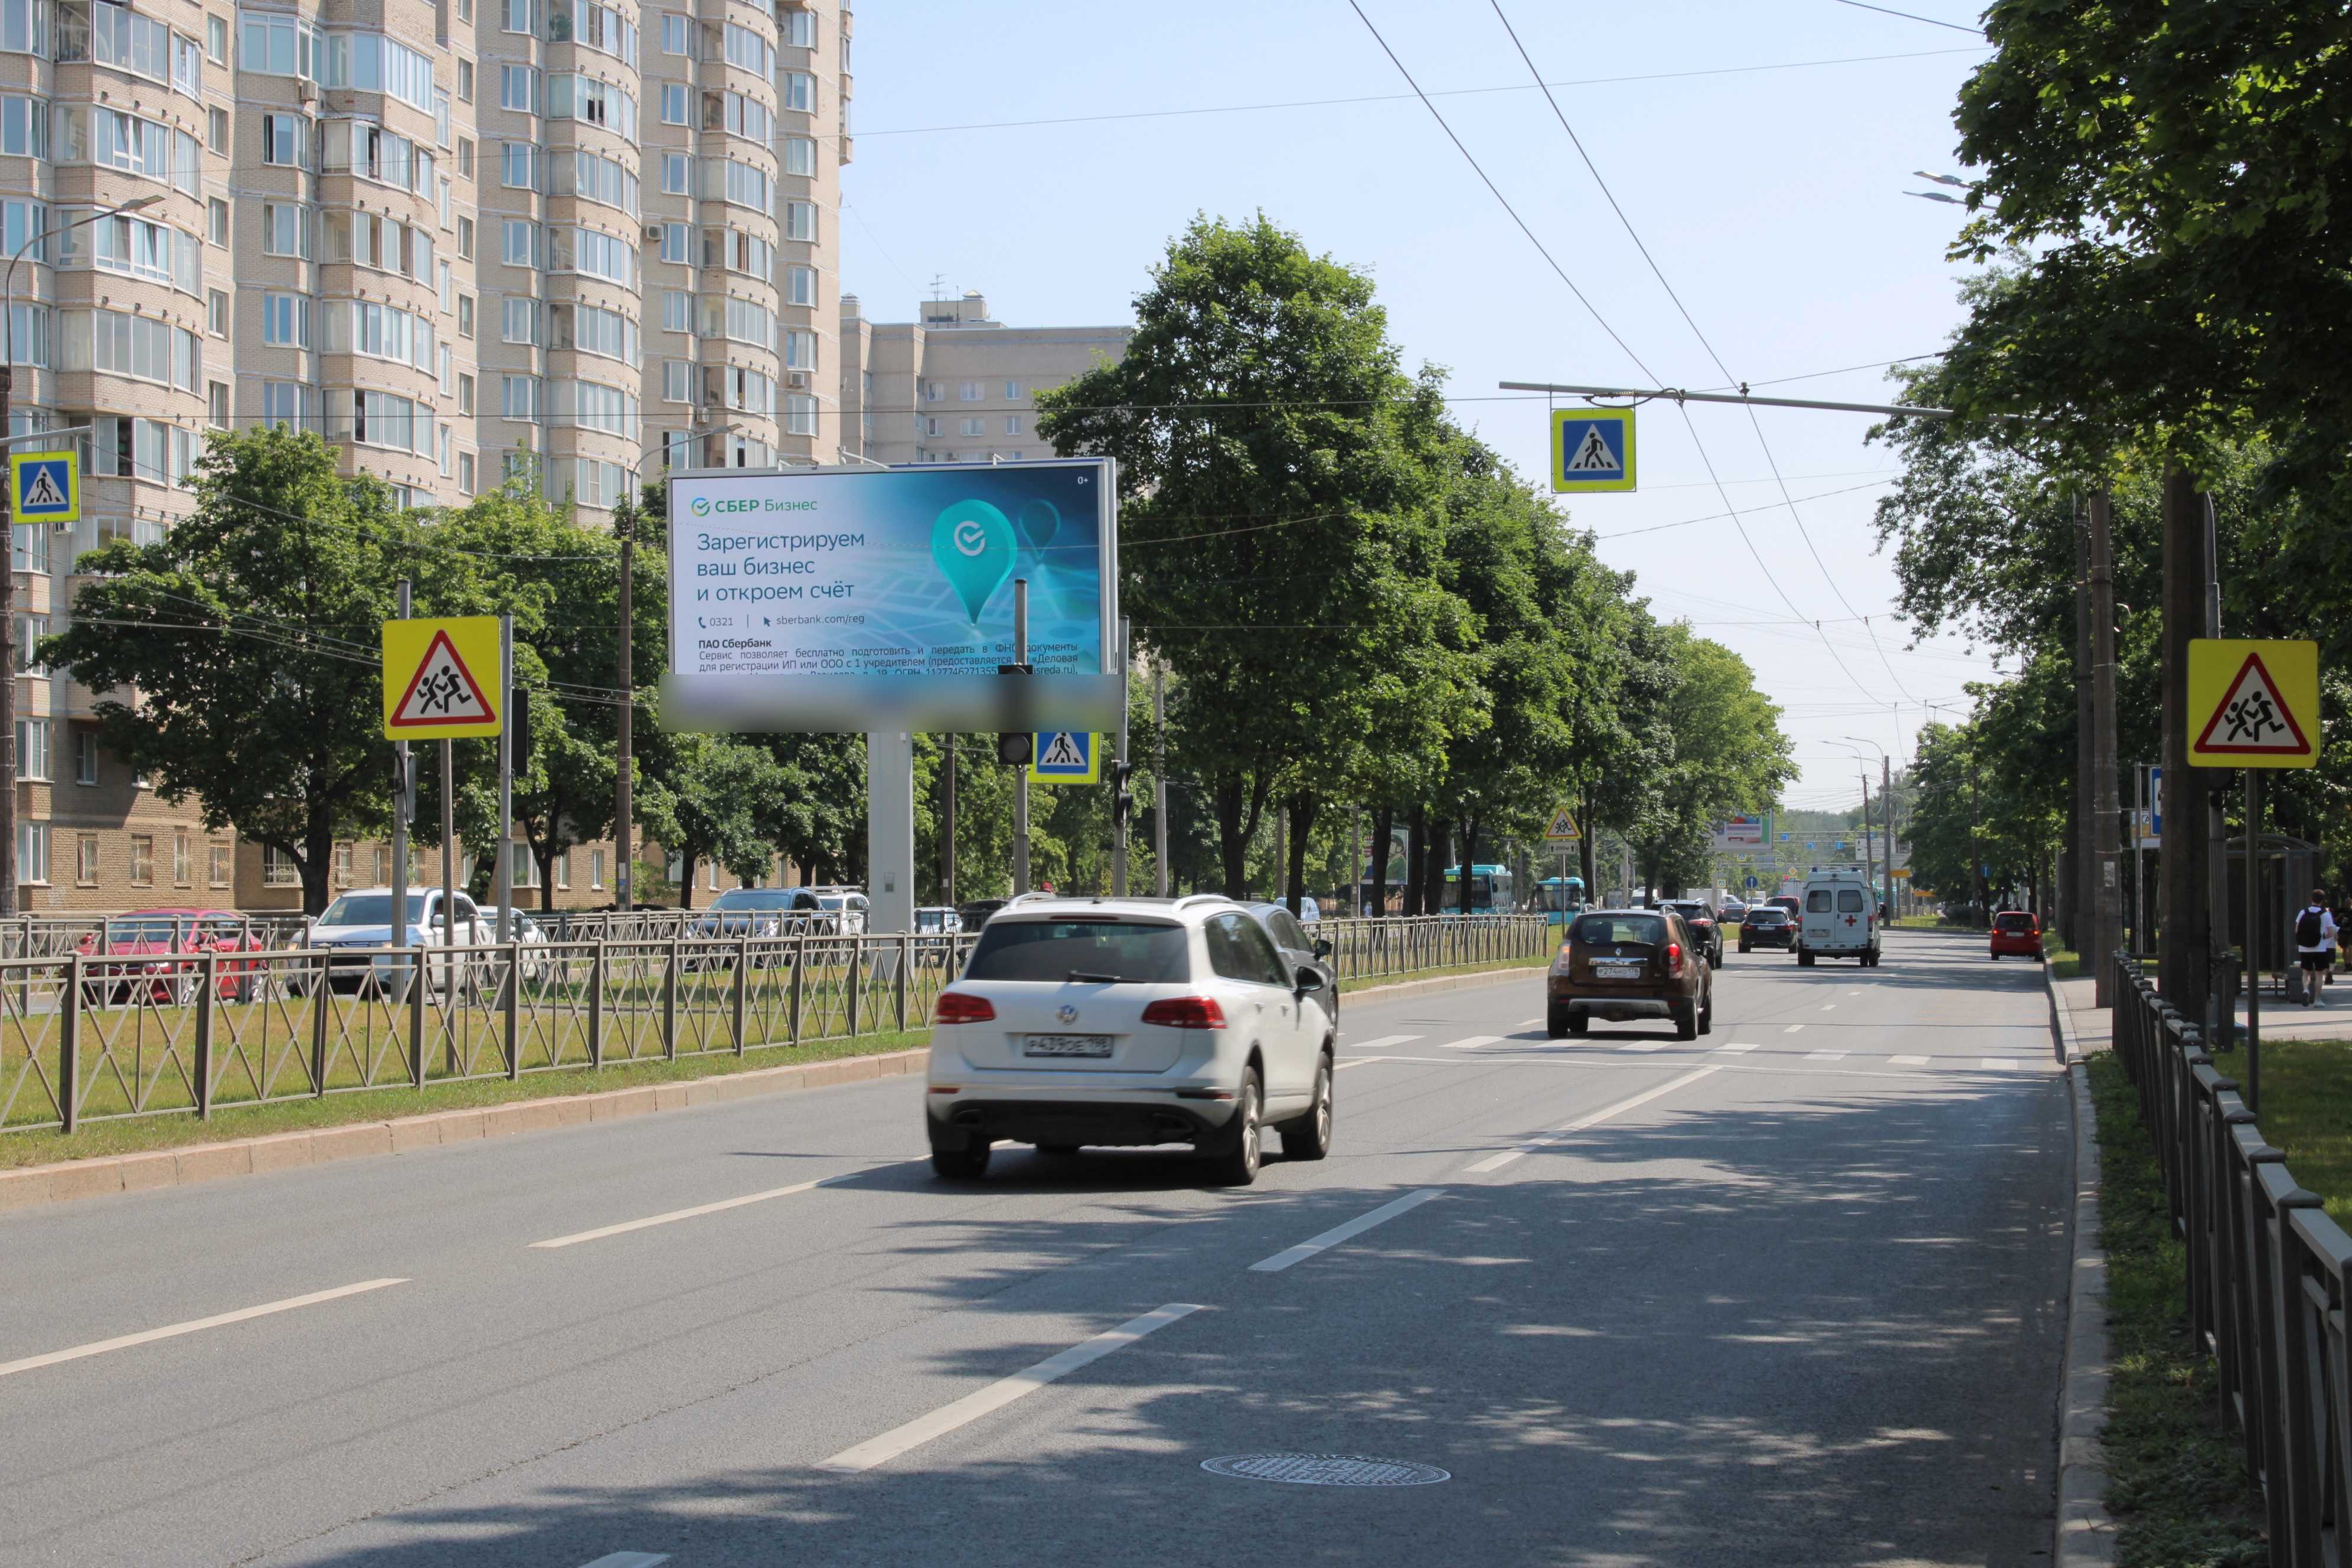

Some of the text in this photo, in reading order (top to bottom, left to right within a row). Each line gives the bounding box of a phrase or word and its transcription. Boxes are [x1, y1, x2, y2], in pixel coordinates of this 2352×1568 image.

[715, 499, 818, 512] СБЕР Бизнес
[697, 533, 864, 554] Зарегистрируем
[697, 557, 815, 576] ваш бизнес
[697, 580, 854, 603] и откроем счёт
[710, 618, 733, 627] 0321
[776, 614, 865, 625] sberbank.com/reg
[698, 638, 772, 649] ПАО Сбербанк
[699, 651, 733, 662] Сервис
[740, 651, 788, 660] позволяет
[796, 648, 844, 658] бесплатно
[852, 646, 910, 658] подготовить
[932, 646, 975, 656] передать
[699, 664, 716, 672] для
[720, 662, 779, 673] регистрации
[783, 660, 796, 669] ИП
[821, 659, 843, 668] ООО
[854, 659, 860, 667] 1
[864, 658, 925, 669] учредителем
[929, 655, 1011, 667] (предоставляется
[1032, 654, 1077, 665] «Деловая
